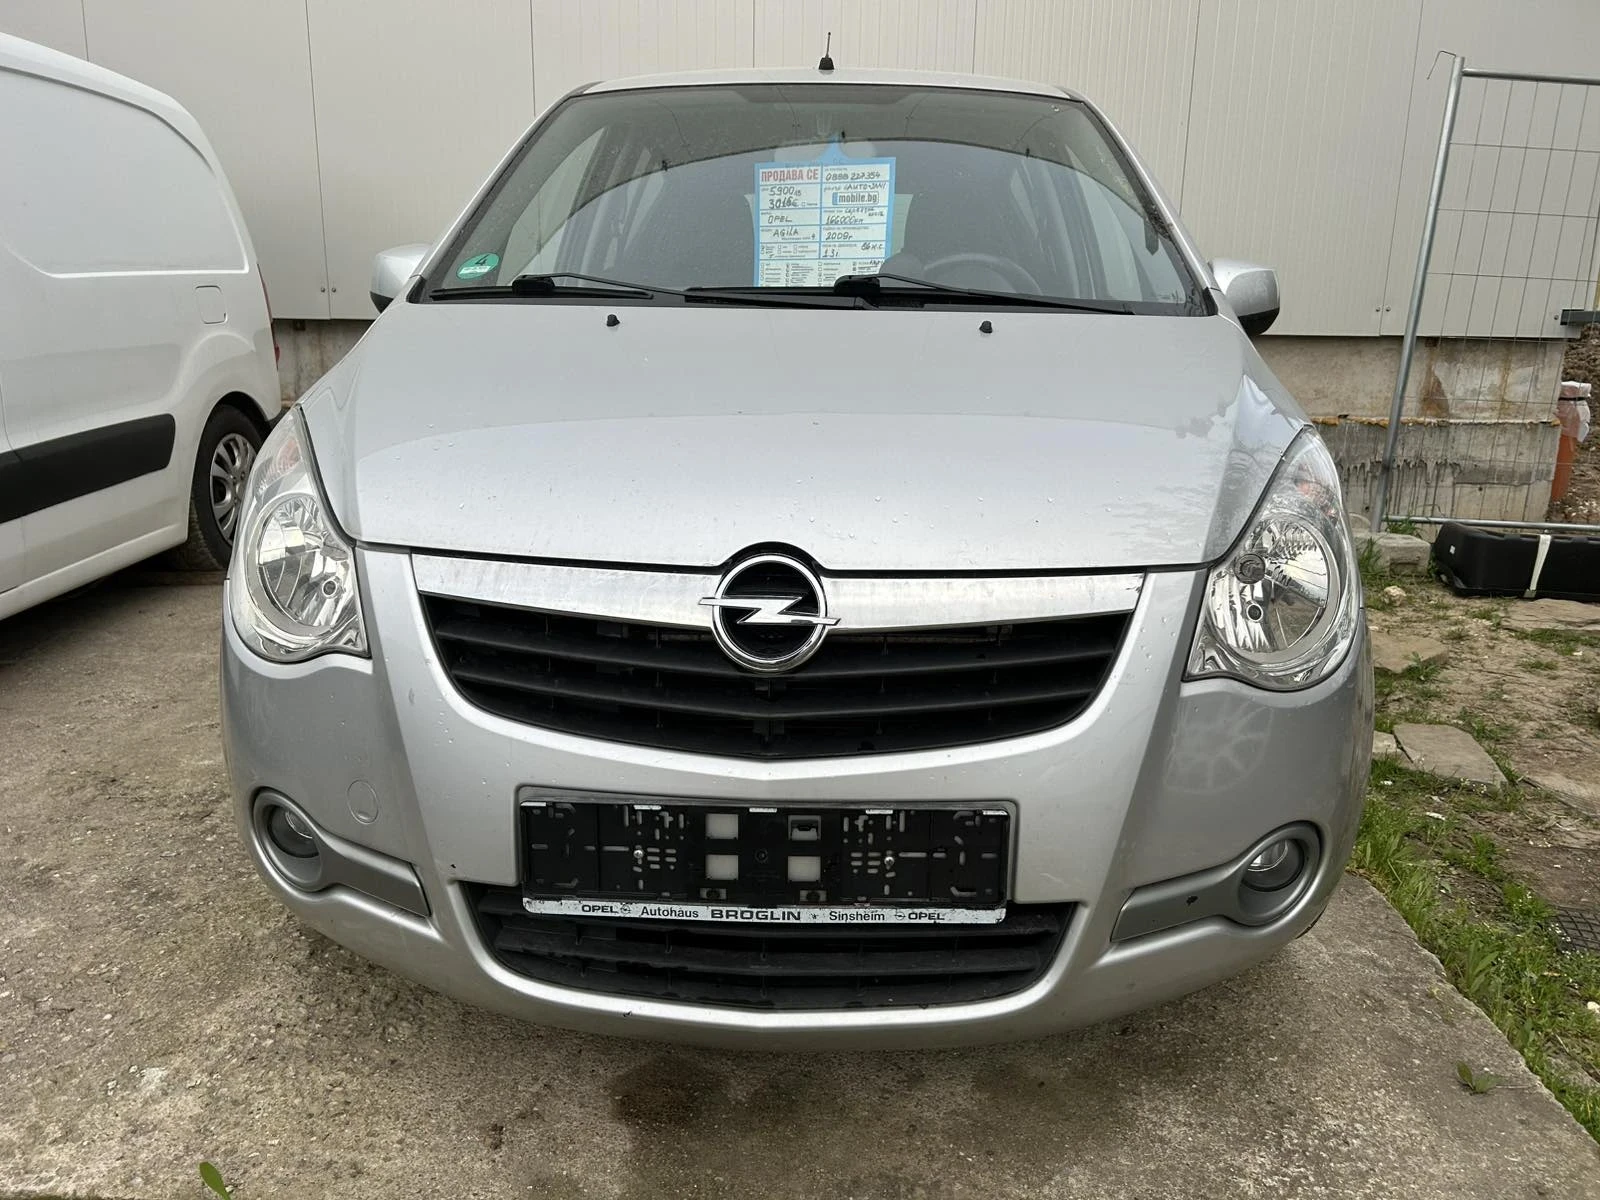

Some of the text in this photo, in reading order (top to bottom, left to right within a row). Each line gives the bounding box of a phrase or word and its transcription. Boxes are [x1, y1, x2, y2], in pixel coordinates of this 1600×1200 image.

[761, 169, 819, 182] ПРОДАВА СЕ
[825, 172, 849, 181] 0888
[838, 192, 877, 203] mobile.bg
[767, 215, 793, 224] OPEL
[475, 254, 489, 266] 4
[581, 904, 618, 914] OPEL
[640, 906, 699, 918] Autohaus
[829, 911, 885, 923] Sinsheim
[908, 912, 945, 921] OPEL
